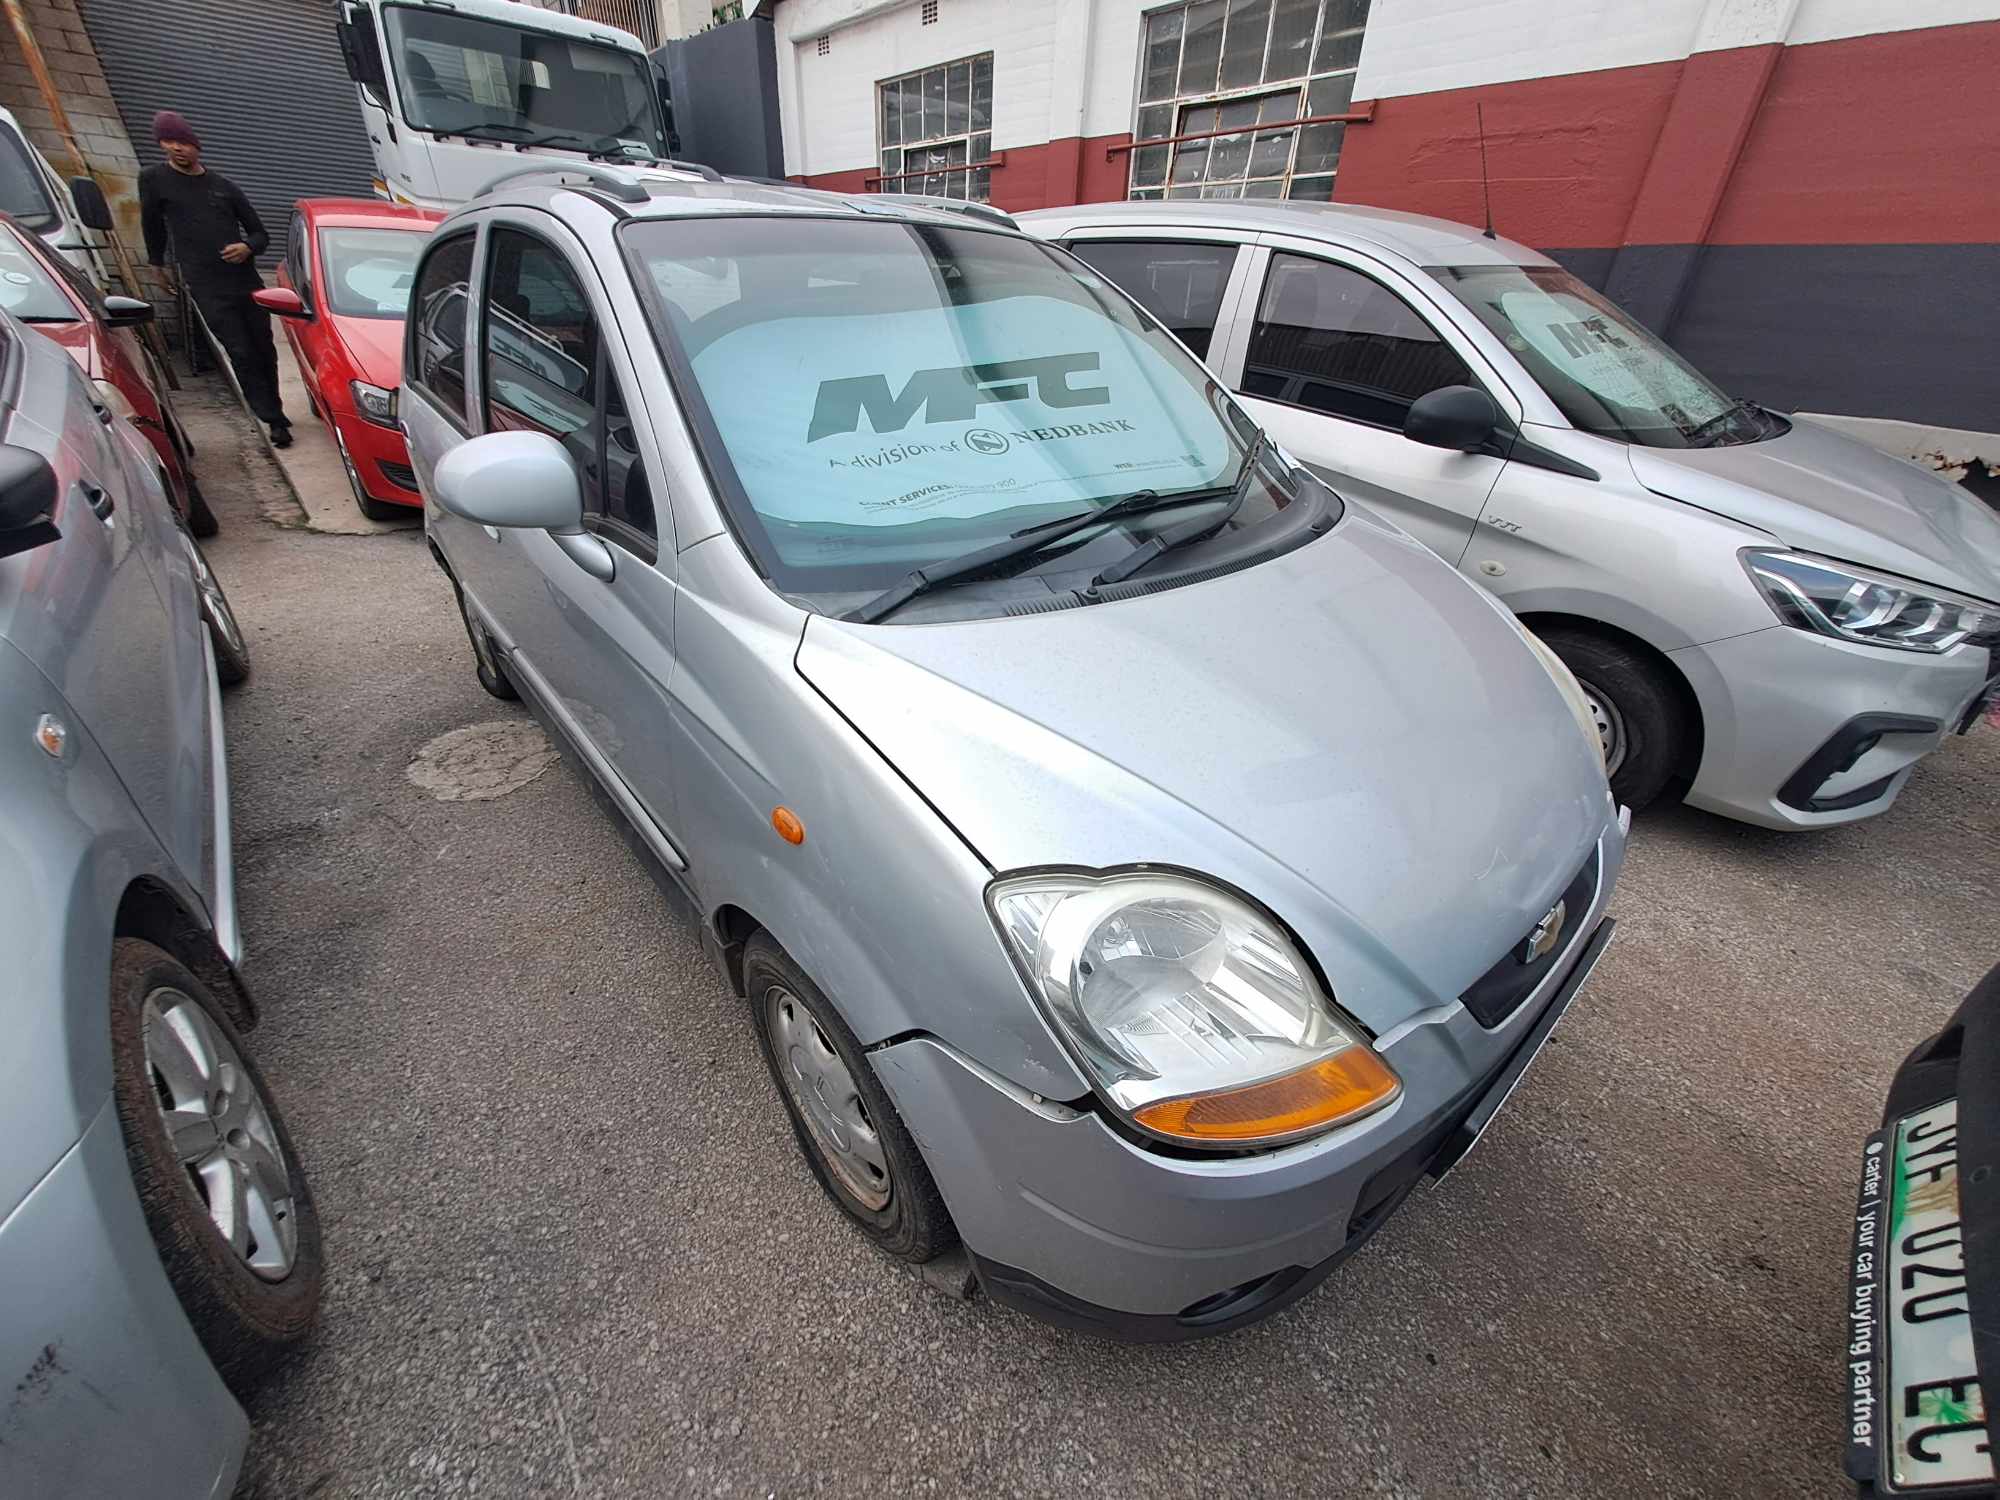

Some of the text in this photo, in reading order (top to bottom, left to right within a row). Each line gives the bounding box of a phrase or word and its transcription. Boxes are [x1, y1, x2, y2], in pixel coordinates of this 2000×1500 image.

[807, 351, 1110, 443] MFC
[851, 443, 936, 468] division
[1010, 419, 1136, 444] NEDBANK
[1864, 1156, 1881, 1196] carter
[1856, 1210, 1876, 1248] your
[1856, 1253, 1873, 1280] car
[1848, 1283, 1877, 1354] buying
[1848, 1359, 1877, 1446] partner
[1905, 1375, 1991, 1463] EC
